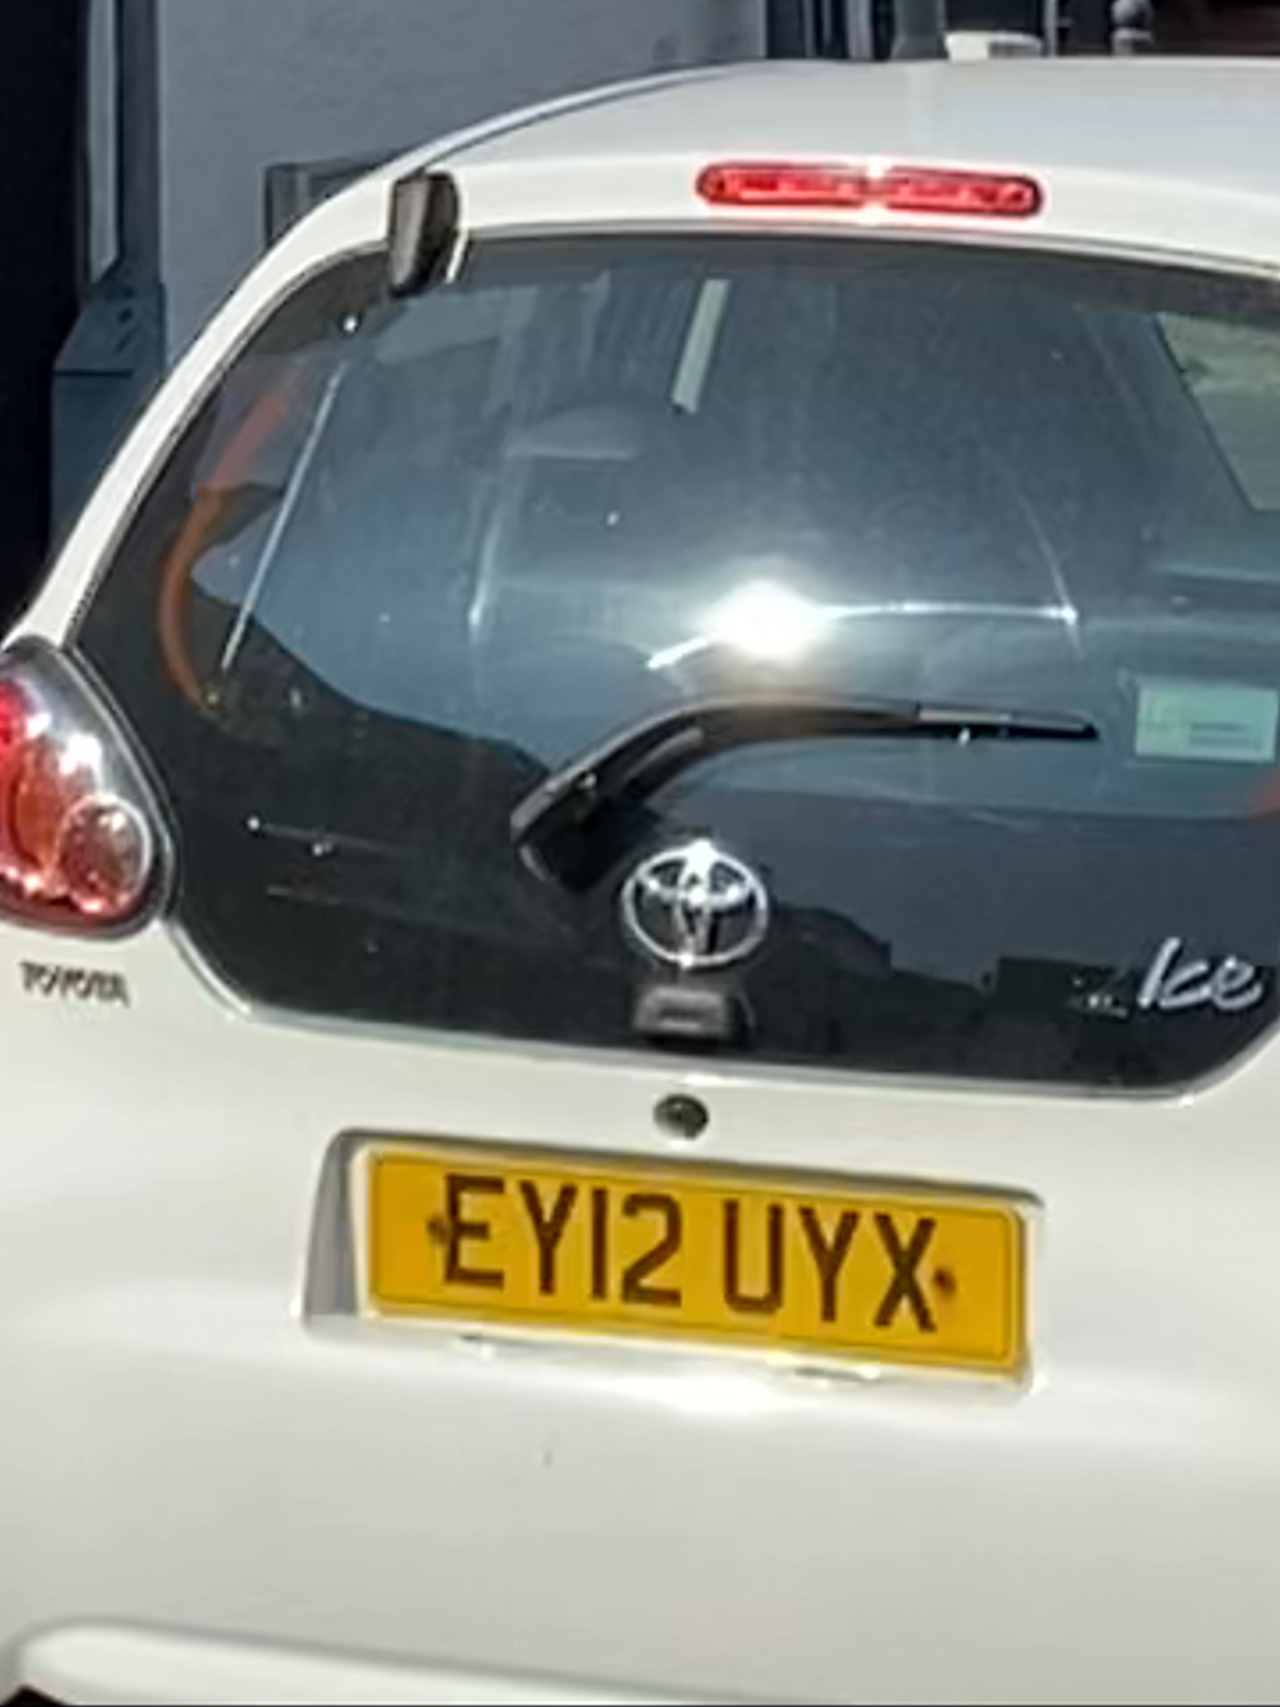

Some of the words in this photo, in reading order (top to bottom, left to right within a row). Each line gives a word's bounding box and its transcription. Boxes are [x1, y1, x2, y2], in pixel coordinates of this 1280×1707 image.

[20, 961, 131, 1009] TOYOTA
[1136, 936, 1263, 1011] Ice
[442, 1173, 684, 1309] EY12
[722, 1197, 938, 1334] UYX
